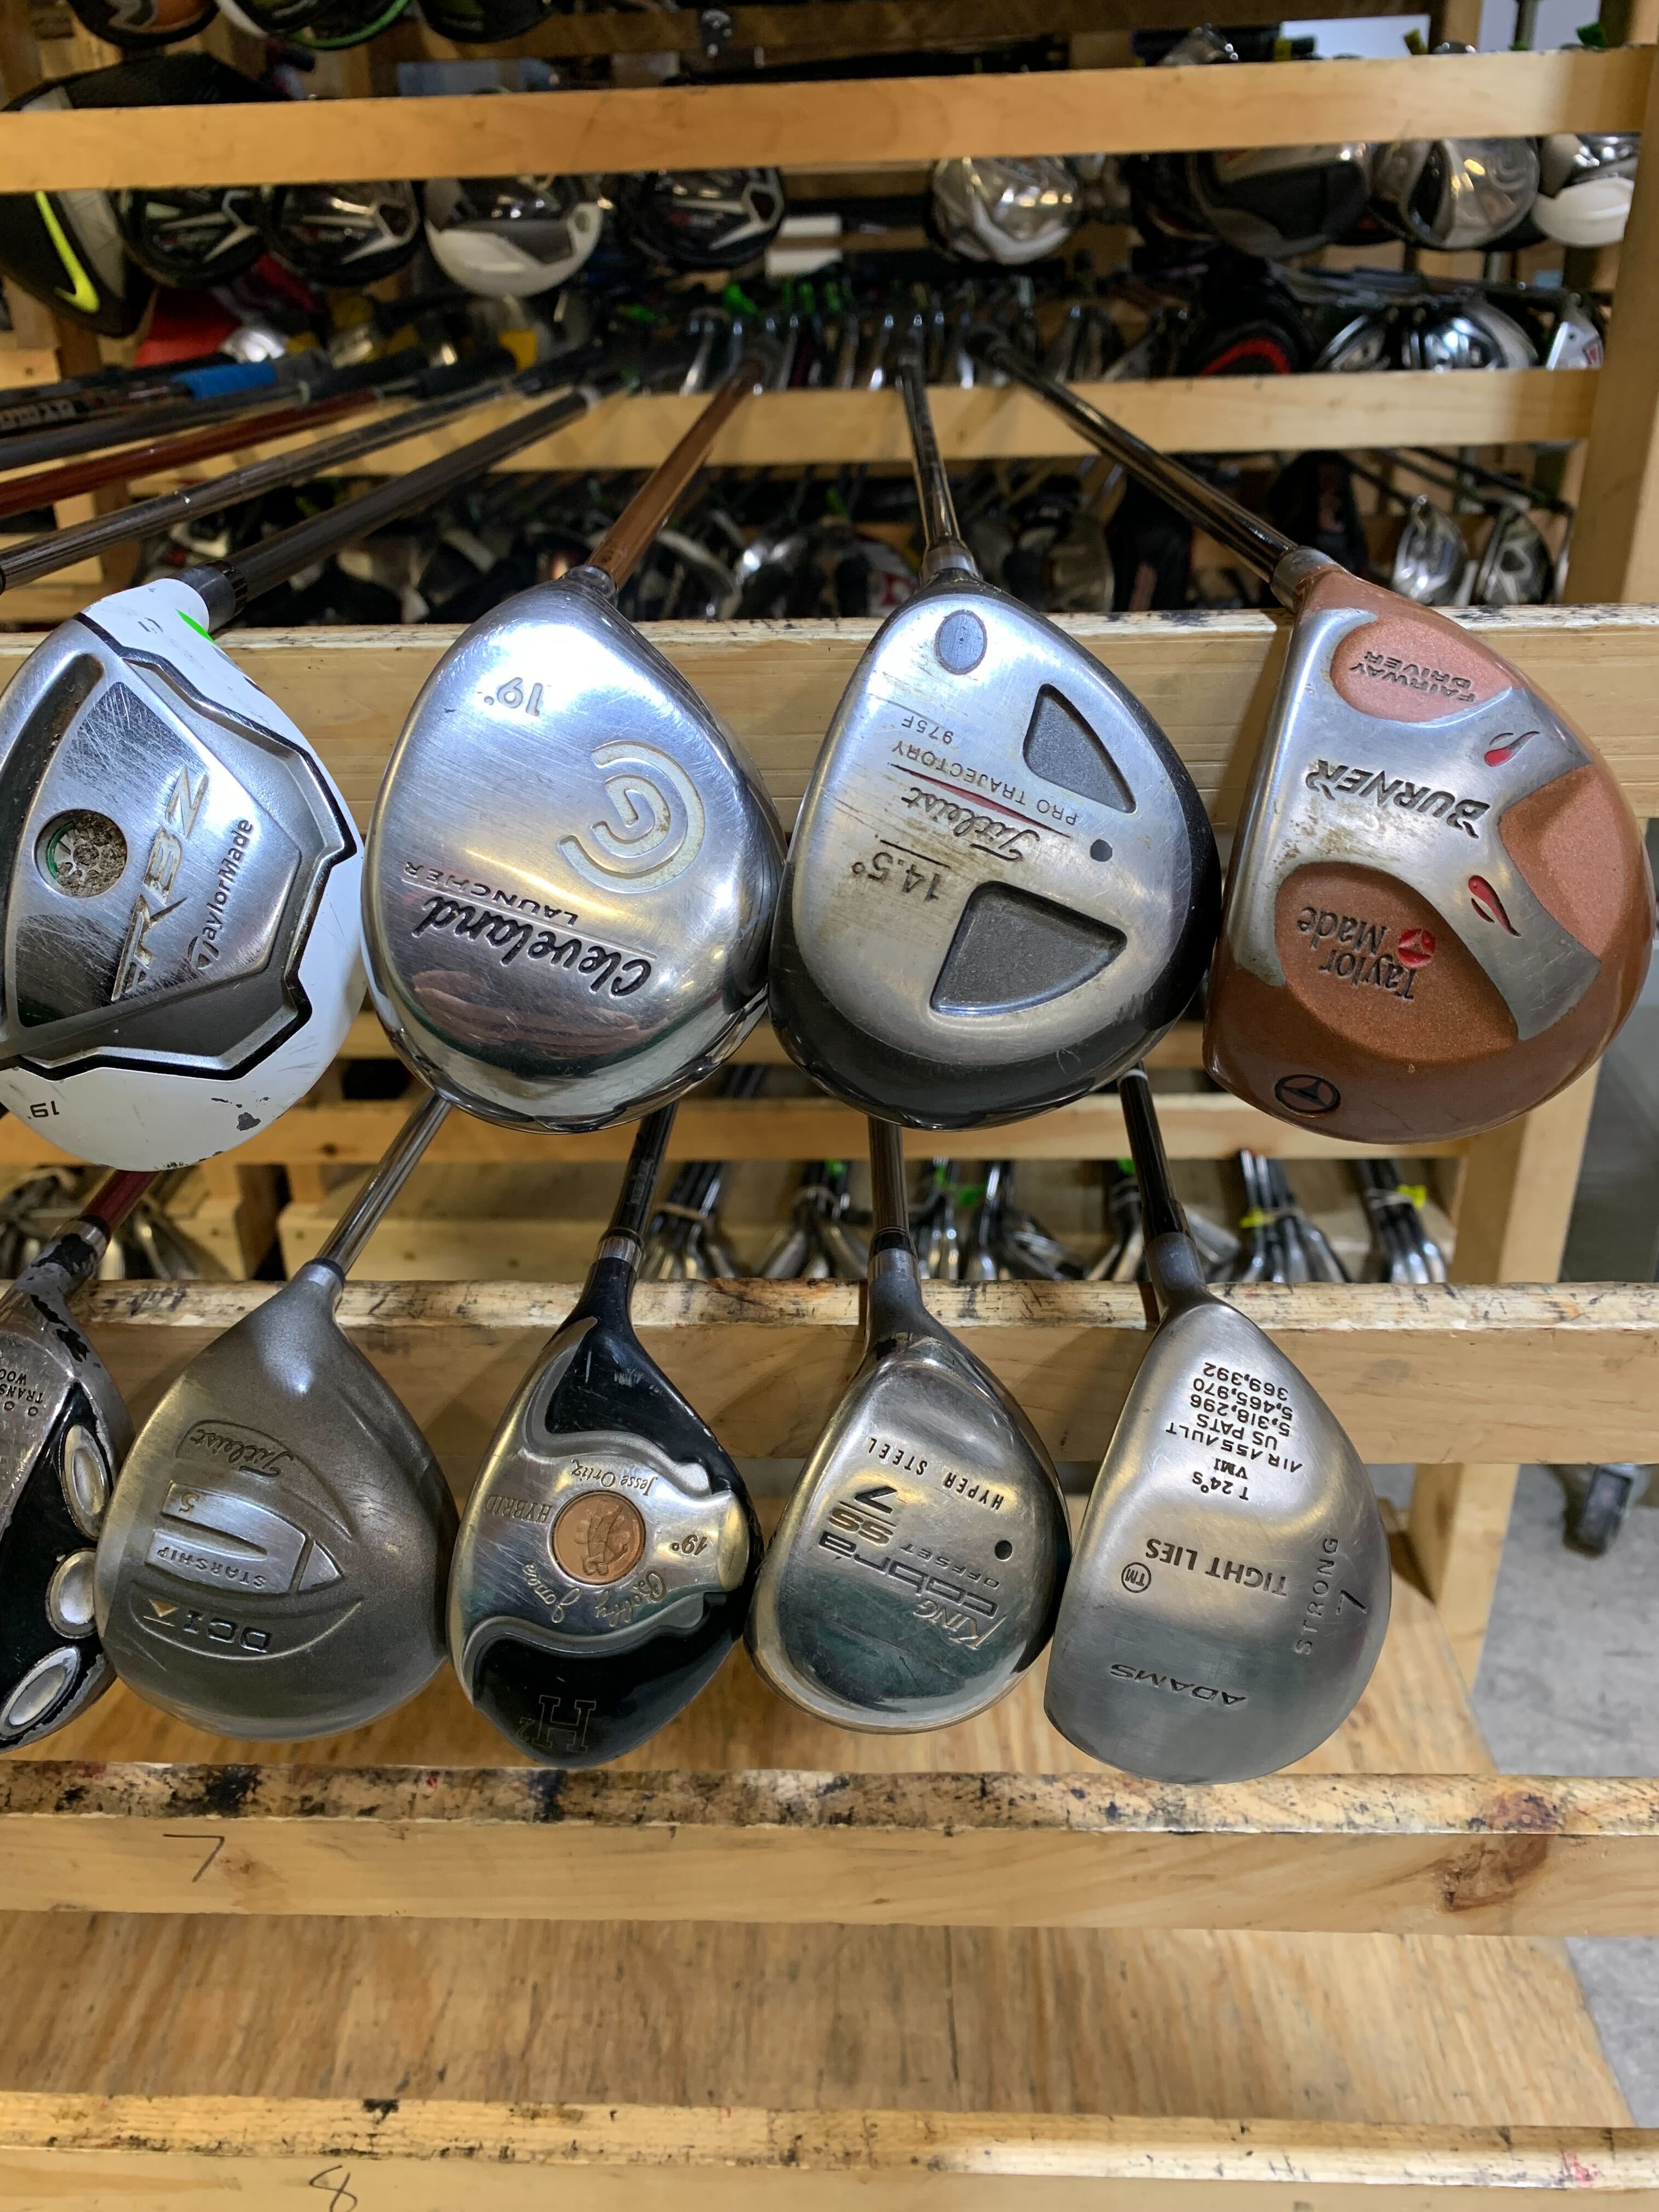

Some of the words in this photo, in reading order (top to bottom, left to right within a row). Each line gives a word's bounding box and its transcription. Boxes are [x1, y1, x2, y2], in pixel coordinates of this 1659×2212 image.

[1351, 662, 1476, 703] FAIRWAY
[1364, 651, 1470, 689] DRIVER
[901, 715, 954, 745] 975F
[891, 740, 1025, 806] TRAJECTORY
[1036, 799, 1077, 826] PRO
[1305, 760, 1491, 838] BURNER
[901, 788, 1040, 862] Titleist
[111, 769, 208, 1001] RBZ
[188, 820, 253, 969] TaylorMade
[405, 860, 579, 925] LAUNCHER
[853, 851, 939, 903] 14.5°
[414, 896, 651, 996] Cleveland
[1297, 906, 1387, 956] Made
[1319, 948, 1418, 1000] Taylor
[1193, 1378, 1293, 1421] 5,465,970
[1203, 1362, 1289, 1401] 369,392
[1189, 1394, 1292, 1437] 5,318,296
[1197, 1413, 1244, 1441] PATS
[189, 1429, 295, 1480] Titleist
[869, 1436, 928, 1478] STEEL
[1251, 1430, 1279, 1449] US
[569, 1459, 616, 1487] Ortiz
[1214, 1458, 1248, 1479] VMI
[1267, 1449, 1304, 1473] AIR
[179, 1491, 198, 1514] 5
[620, 1472, 657, 1497] Jesse
[854, 1485, 898, 1515] 7
[944, 1472, 1004, 1509] HYPER
[484, 1495, 552, 1523] HYBRID
[829, 1508, 894, 1546] SS
[670, 1533, 708, 1556] 19°
[900, 1542, 1000, 1589] OFFSET
[1146, 1538, 1197, 1571] LIES
[157, 1548, 266, 1589] STARSHIP
[818, 1530, 998, 1617] cobra
[1204, 1556, 1288, 1598] TIGHT
[522, 1561, 580, 1621] Jones
[594, 1569, 667, 1628] Bobby
[1295, 1537, 1339, 1656] STRONG
[185, 1611, 272, 1652] DCI
[914, 1596, 1008, 1650] KING
[1110, 1663, 1246, 1707] ADAMS
[163, 1832, 225, 1883] 7
[308, 2165, 358, 2212] 8
